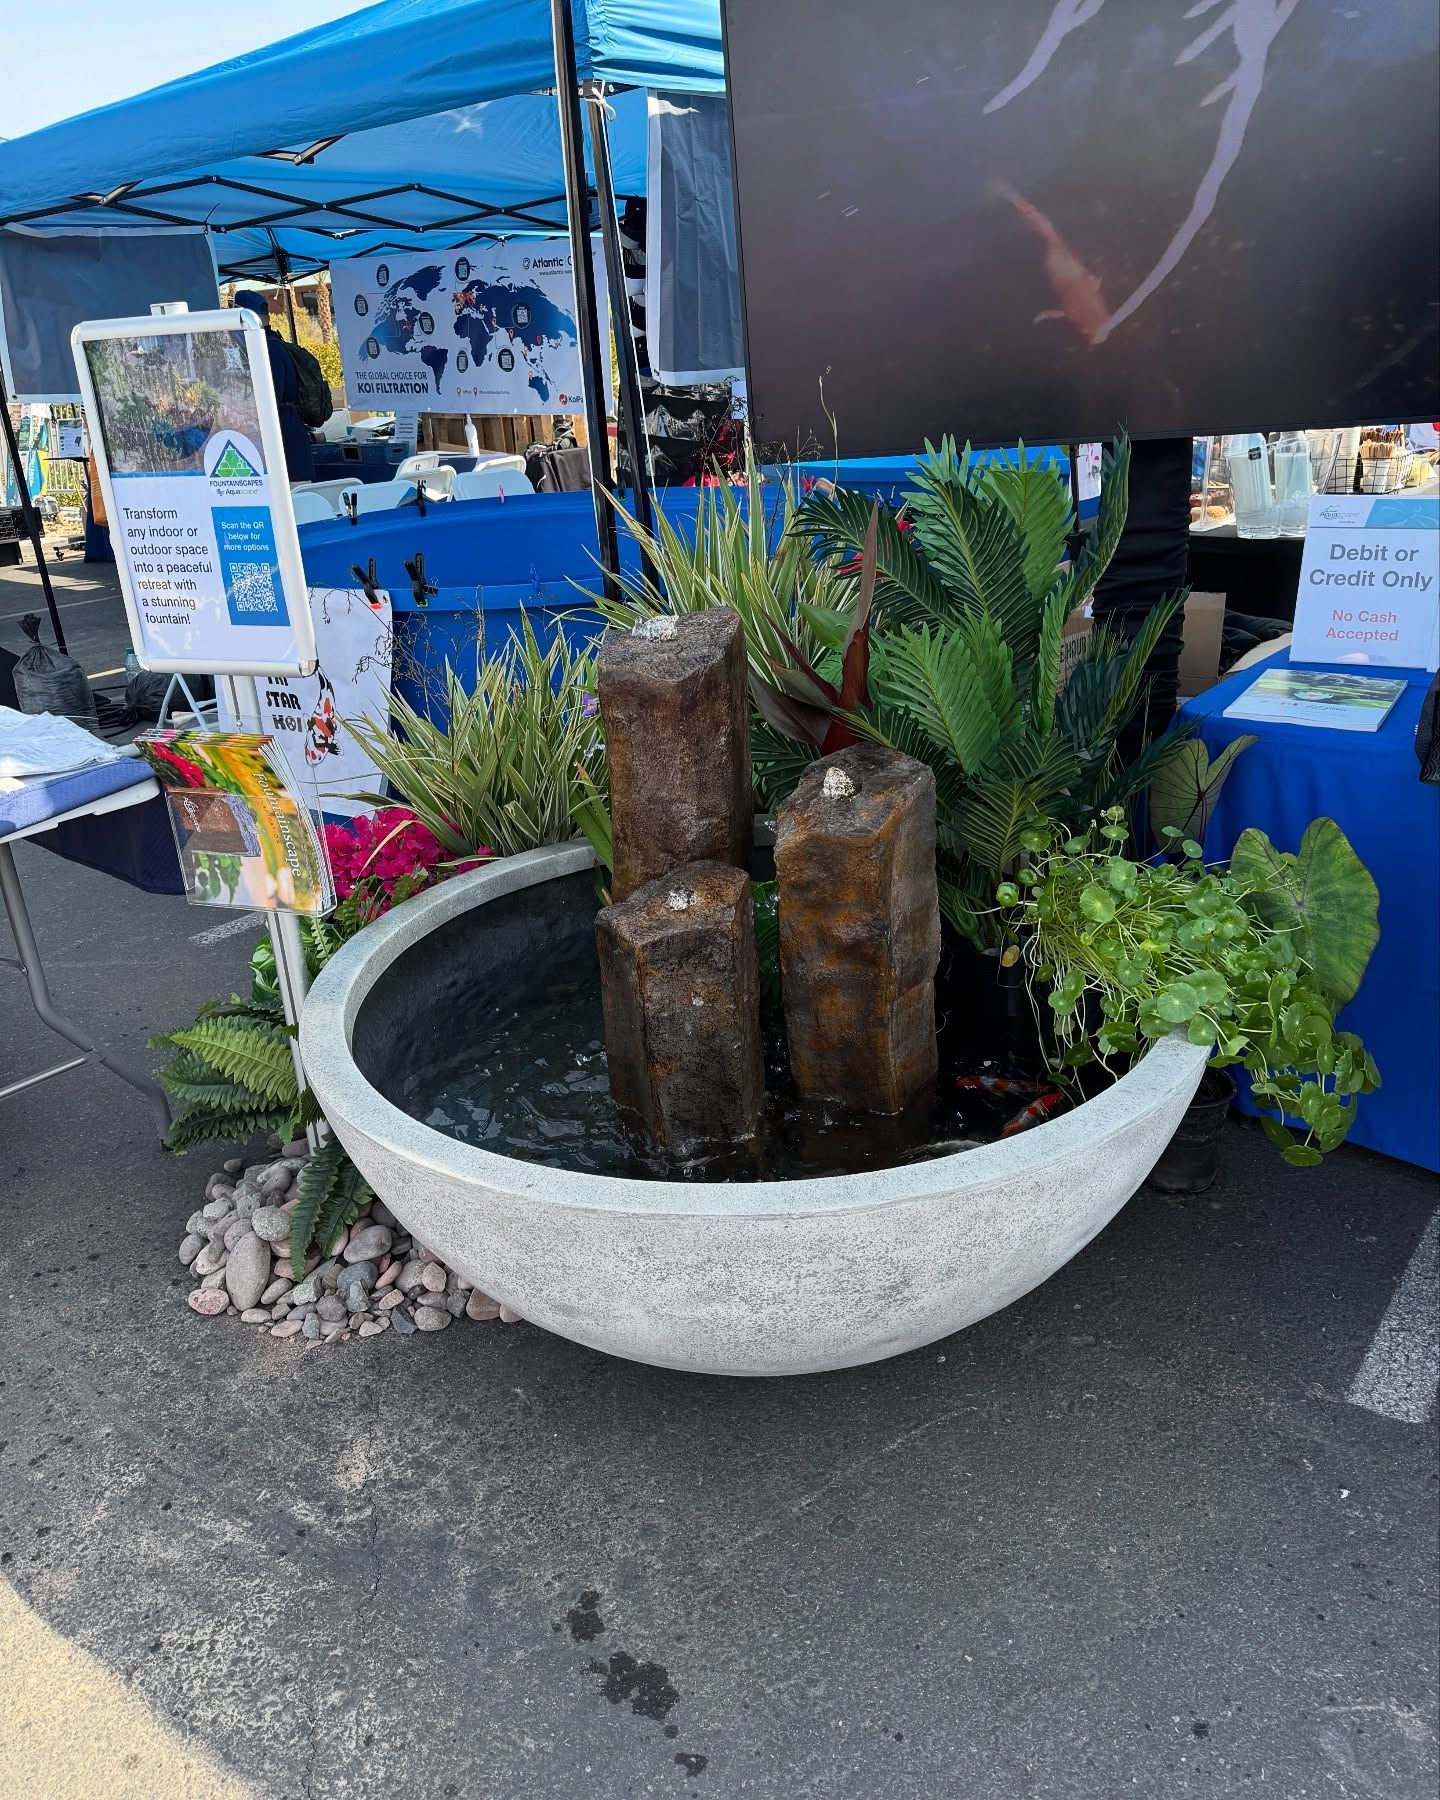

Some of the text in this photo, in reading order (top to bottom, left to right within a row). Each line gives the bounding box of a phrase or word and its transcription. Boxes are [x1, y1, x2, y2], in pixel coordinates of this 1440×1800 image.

[532, 256, 564, 268] Atlantic
[355, 371, 428, 380] THE GLOBAL CHOICE FOR
[357, 382, 429, 394] KOI FILTRATION
[209, 479, 264, 488] FOUNTAINSCAPES
[123, 507, 178, 520] Transform
[221, 521, 265, 529] Scan the QR
[127, 525, 198, 540] any indoor or
[228, 532, 260, 540] below for
[130, 543, 209, 557] outdoor space
[242, 543, 270, 552] options
[1329, 543, 1419, 562] Debit or
[133, 561, 213, 575] into a peaceful
[137, 579, 197, 590] retreat with
[1309, 568, 1434, 592] Credit Only
[141, 596, 196, 610] a stunning
[145, 612, 191, 625] fountain!
[1332, 609, 1397, 624] No Cash
[1325, 626, 1399, 643] Accepted
[265, 690, 302, 710] STAR
[271, 714, 303, 733] KOI
[253, 771, 302, 877] Fountainscape
